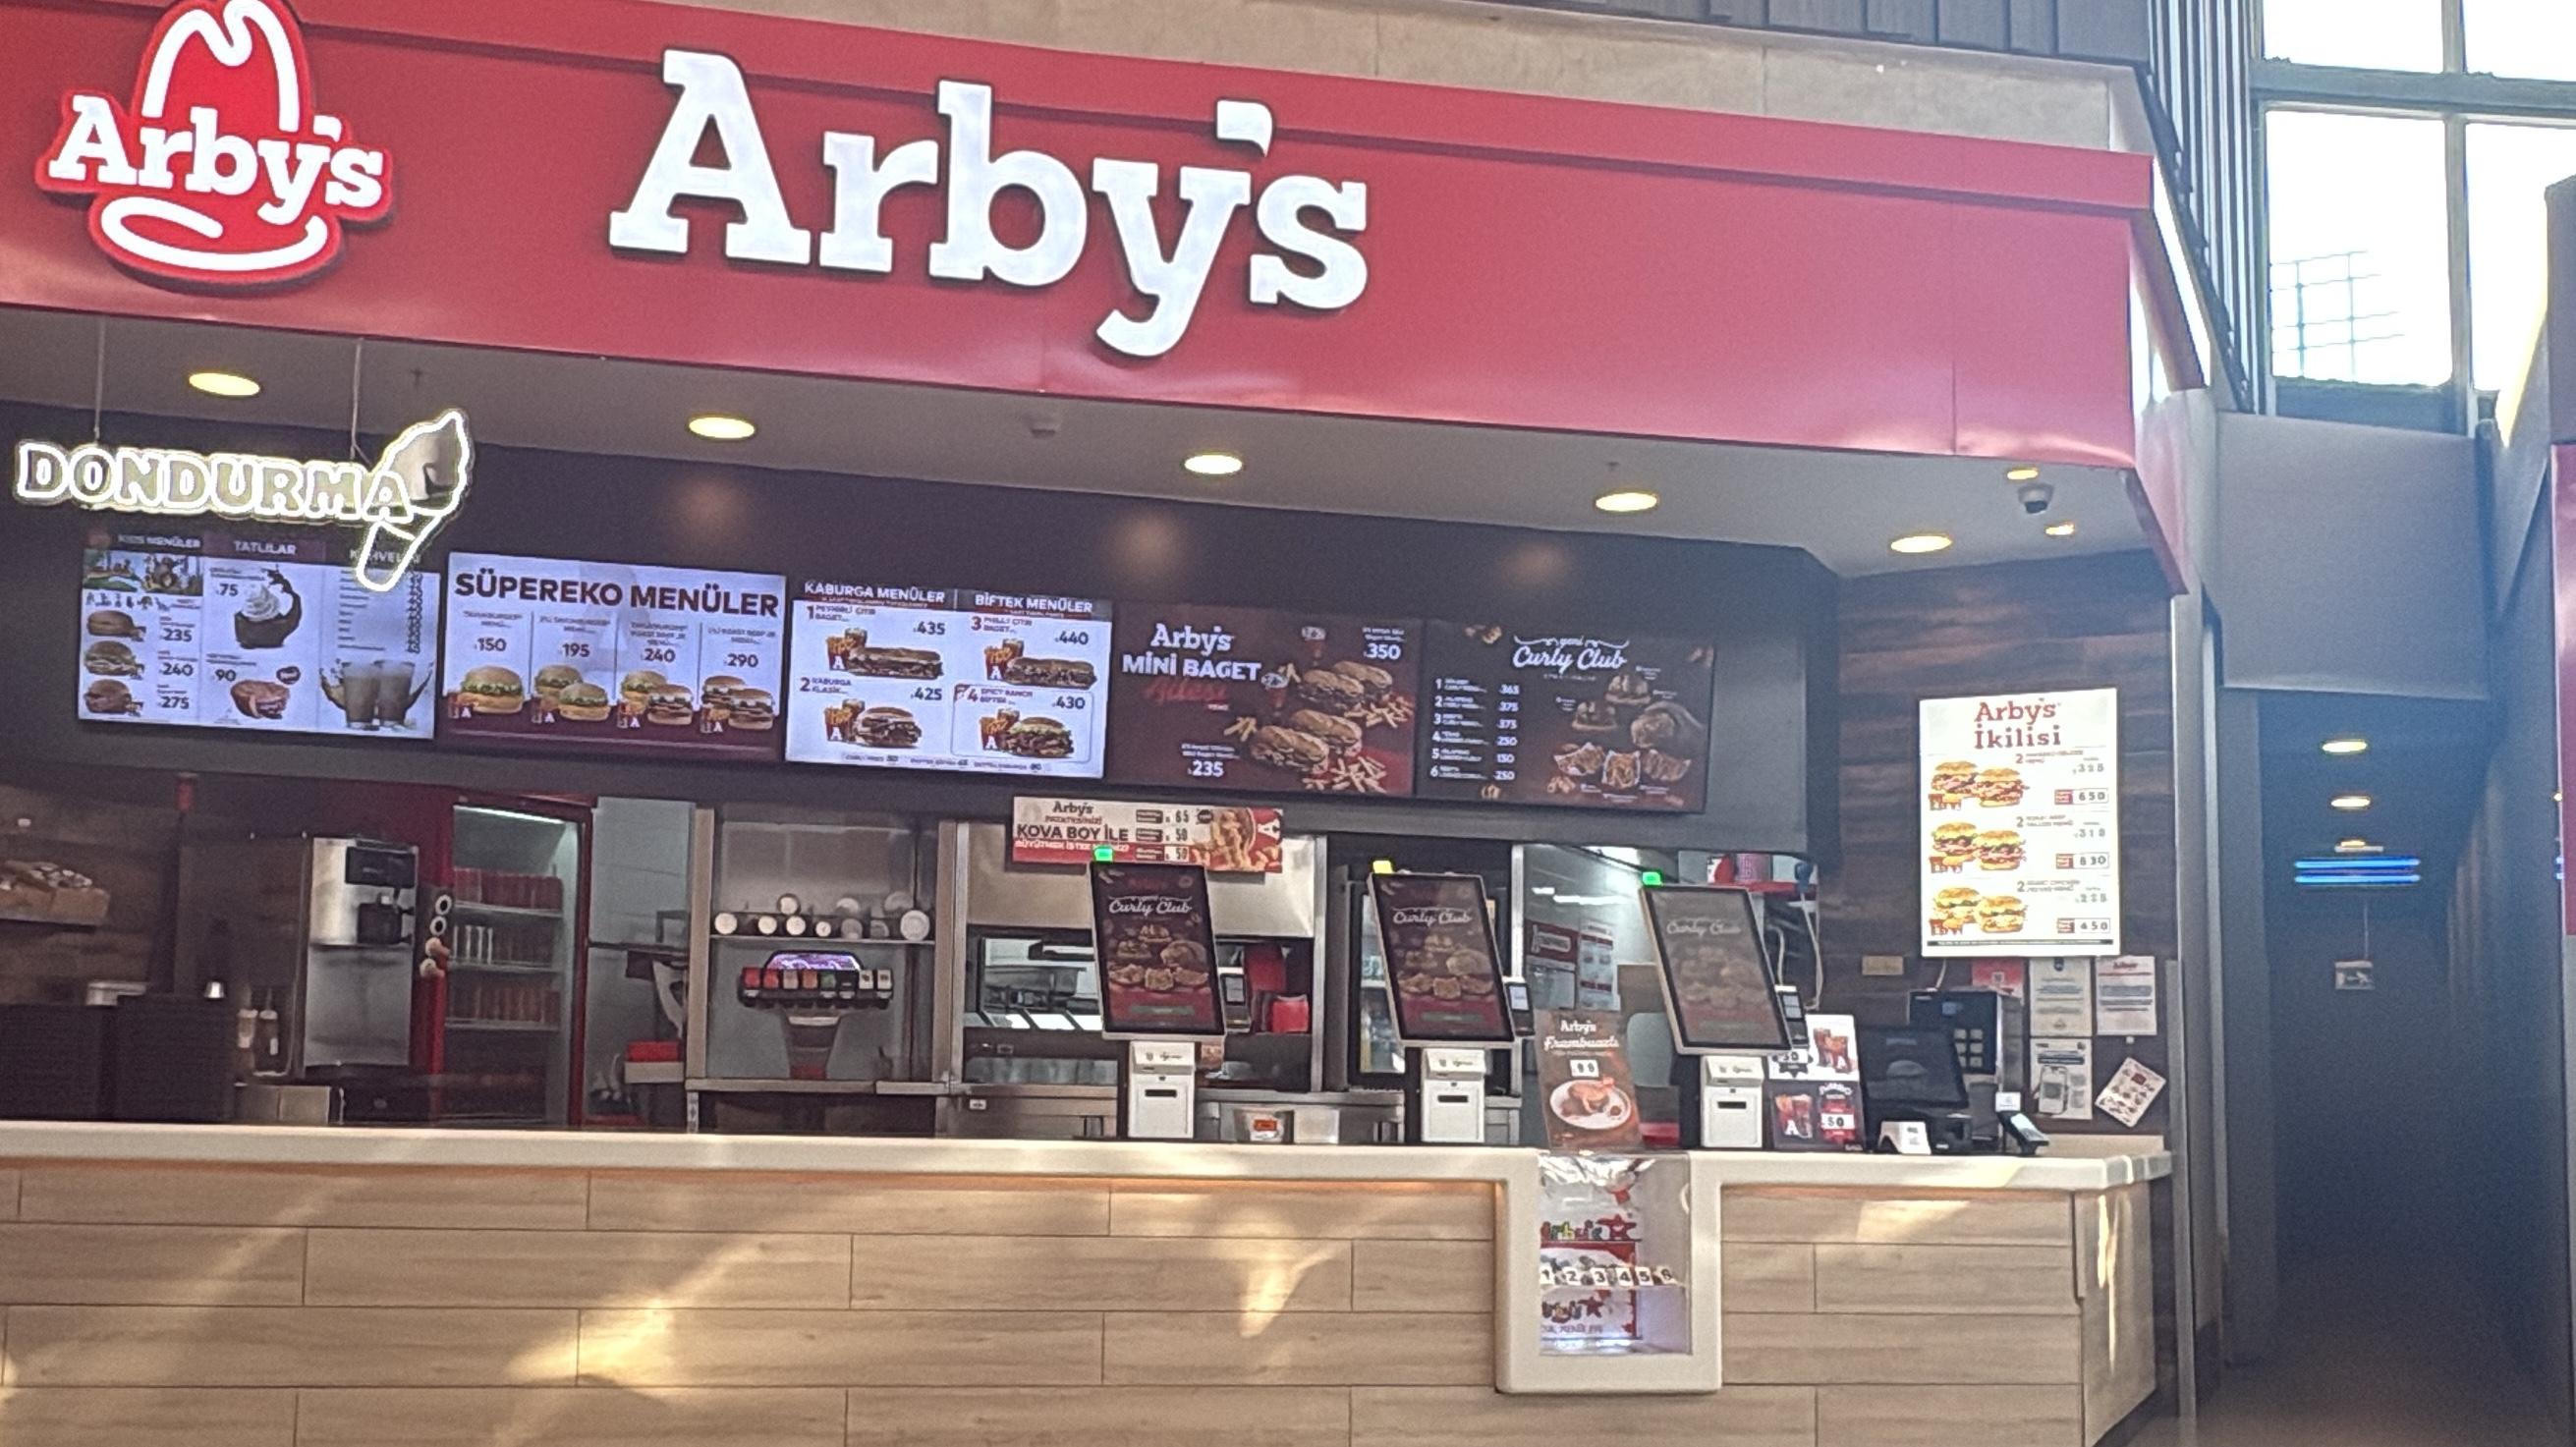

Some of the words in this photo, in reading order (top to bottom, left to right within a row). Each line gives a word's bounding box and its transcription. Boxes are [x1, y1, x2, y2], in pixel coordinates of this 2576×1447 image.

[49, 95, 383, 225] Arby's
[609, 49, 1368, 358] Arby's
[15, 441, 415, 525] DONDURMA
[455, 568, 623, 606] SÜPEREKO
[631, 583, 780, 618] MENÜLER
[805, 582, 873, 597] KABURGA
[877, 586, 946, 603] MENÜLER
[975, 592, 1024, 608] BİFTEK
[1027, 596, 1092, 613] MENÜLER
[916, 622, 946, 636] 435
[973, 616, 981, 631] 3
[162, 628, 193, 642] 235
[1058, 631, 1090, 645] 440
[1150, 623, 1233, 656] Arby's
[476, 638, 506, 652] 150
[563, 643, 590, 657] 195
[1366, 642, 1402, 660] 350
[644, 648, 676, 663] 240
[727, 653, 758, 668] 290
[1513, 645, 1575, 674] Curly
[1577, 646, 1628, 671] Club
[1122, 651, 1177, 676] MİNİ
[1182, 658, 1262, 682] BAGET
[800, 677, 811, 693] 2
[1435, 678, 1442, 691] 1
[914, 688, 943, 701] 425
[160, 696, 190, 709] 275
[1055, 696, 1086, 710] 430
[1434, 696, 1443, 708] 2
[1975, 697, 2056, 725] Arby's
[1432, 713, 1442, 725] 3
[1431, 730, 1441, 743] 4
[1975, 724, 2061, 750] İkilisi
[1430, 748, 1439, 759] 5
[1192, 760, 1225, 777] 235
[1429, 765, 1439, 777] 6
[1052, 801, 1093, 815] Arby's
[1017, 824, 1063, 839] KOVA
[1067, 826, 1100, 840] BOY
[1104, 823, 1129, 842] İLE
[1109, 899, 1153, 917] Curly
[1156, 901, 1193, 915] Club
[1567, 1270, 1578, 1282] 2
[1594, 1270, 1605, 1283] 3
[1619, 1270, 1631, 1282] 4
[1639, 1270, 1651, 1282] 5
